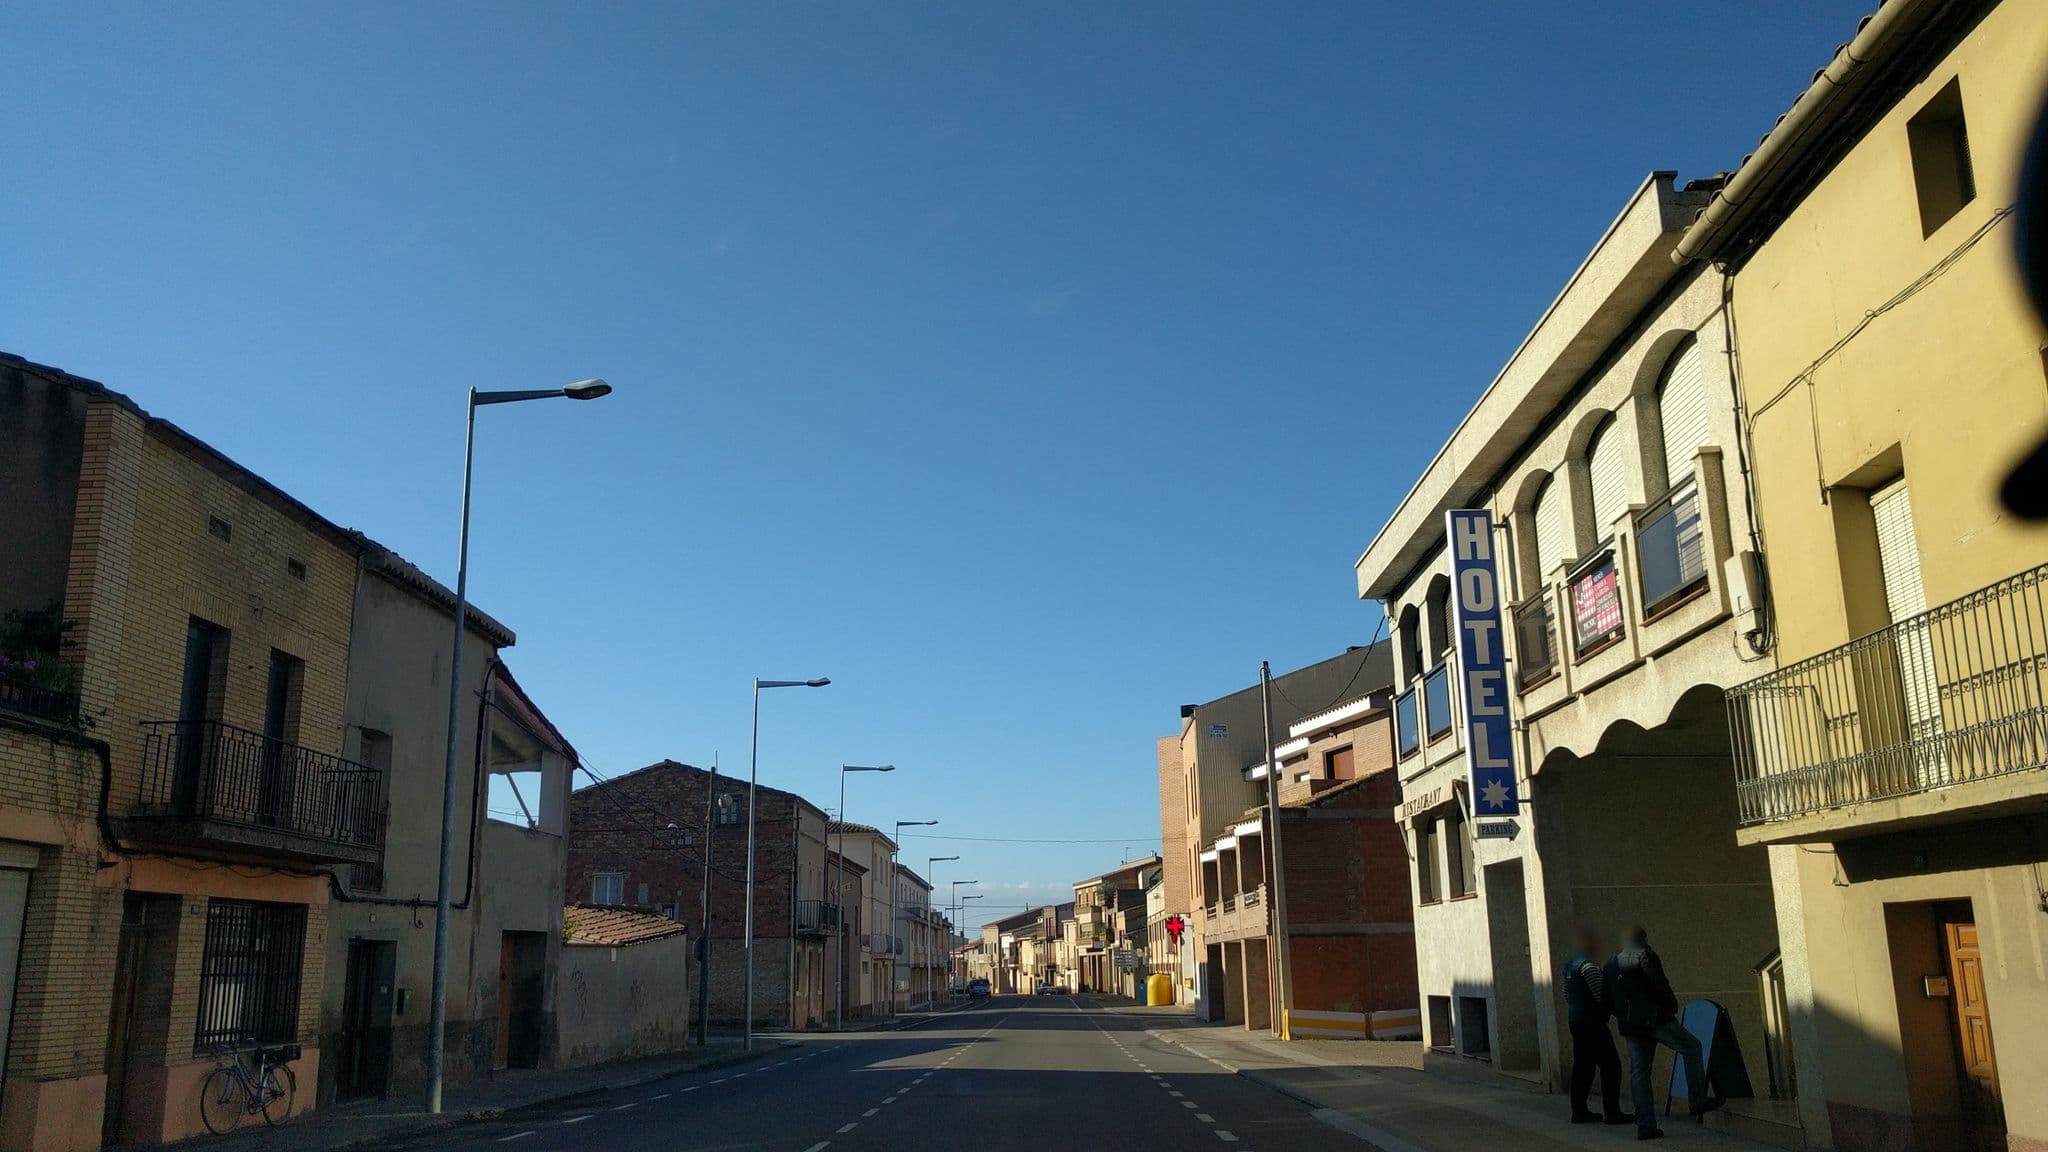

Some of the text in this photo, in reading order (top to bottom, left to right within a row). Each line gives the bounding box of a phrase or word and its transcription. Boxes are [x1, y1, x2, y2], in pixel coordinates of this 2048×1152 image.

[1456, 516, 1509, 768] HOTEL
[1402, 786, 1442, 818] RESTAURANT
[1481, 823, 1513, 835] PARKING
